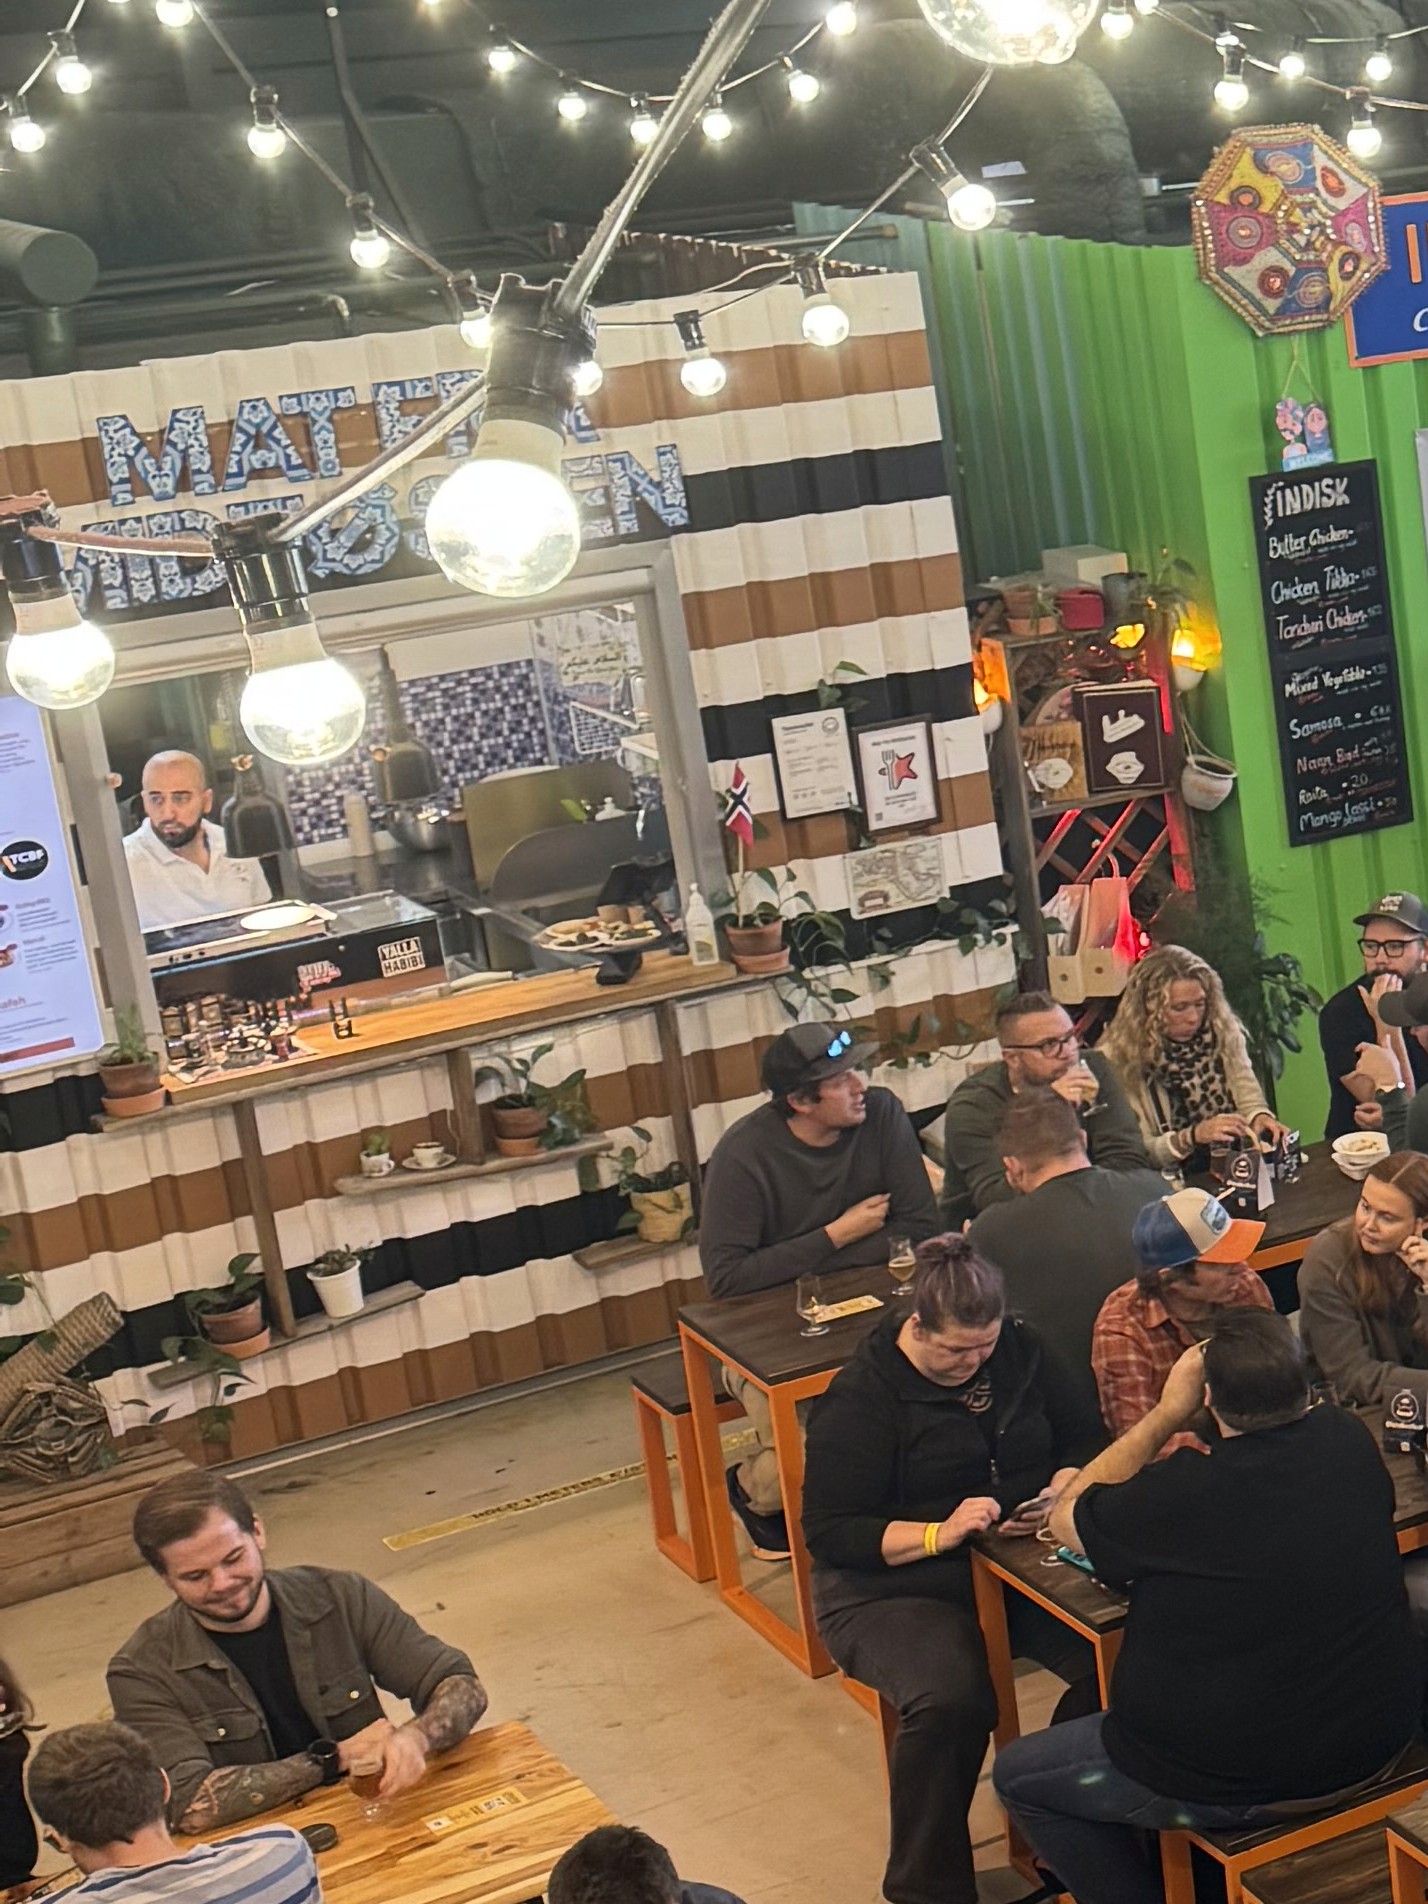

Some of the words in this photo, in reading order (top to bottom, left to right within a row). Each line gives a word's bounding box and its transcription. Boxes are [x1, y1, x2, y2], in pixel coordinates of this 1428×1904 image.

[97, 386, 356, 507] MAT
[1276, 476, 1350, 517] INDISK
[1289, 716, 1343, 740] Samosa
[1299, 810, 1342, 832] Mango
[9, 849, 45, 865] TCBF
[383, 956, 424, 975] HABIBI
